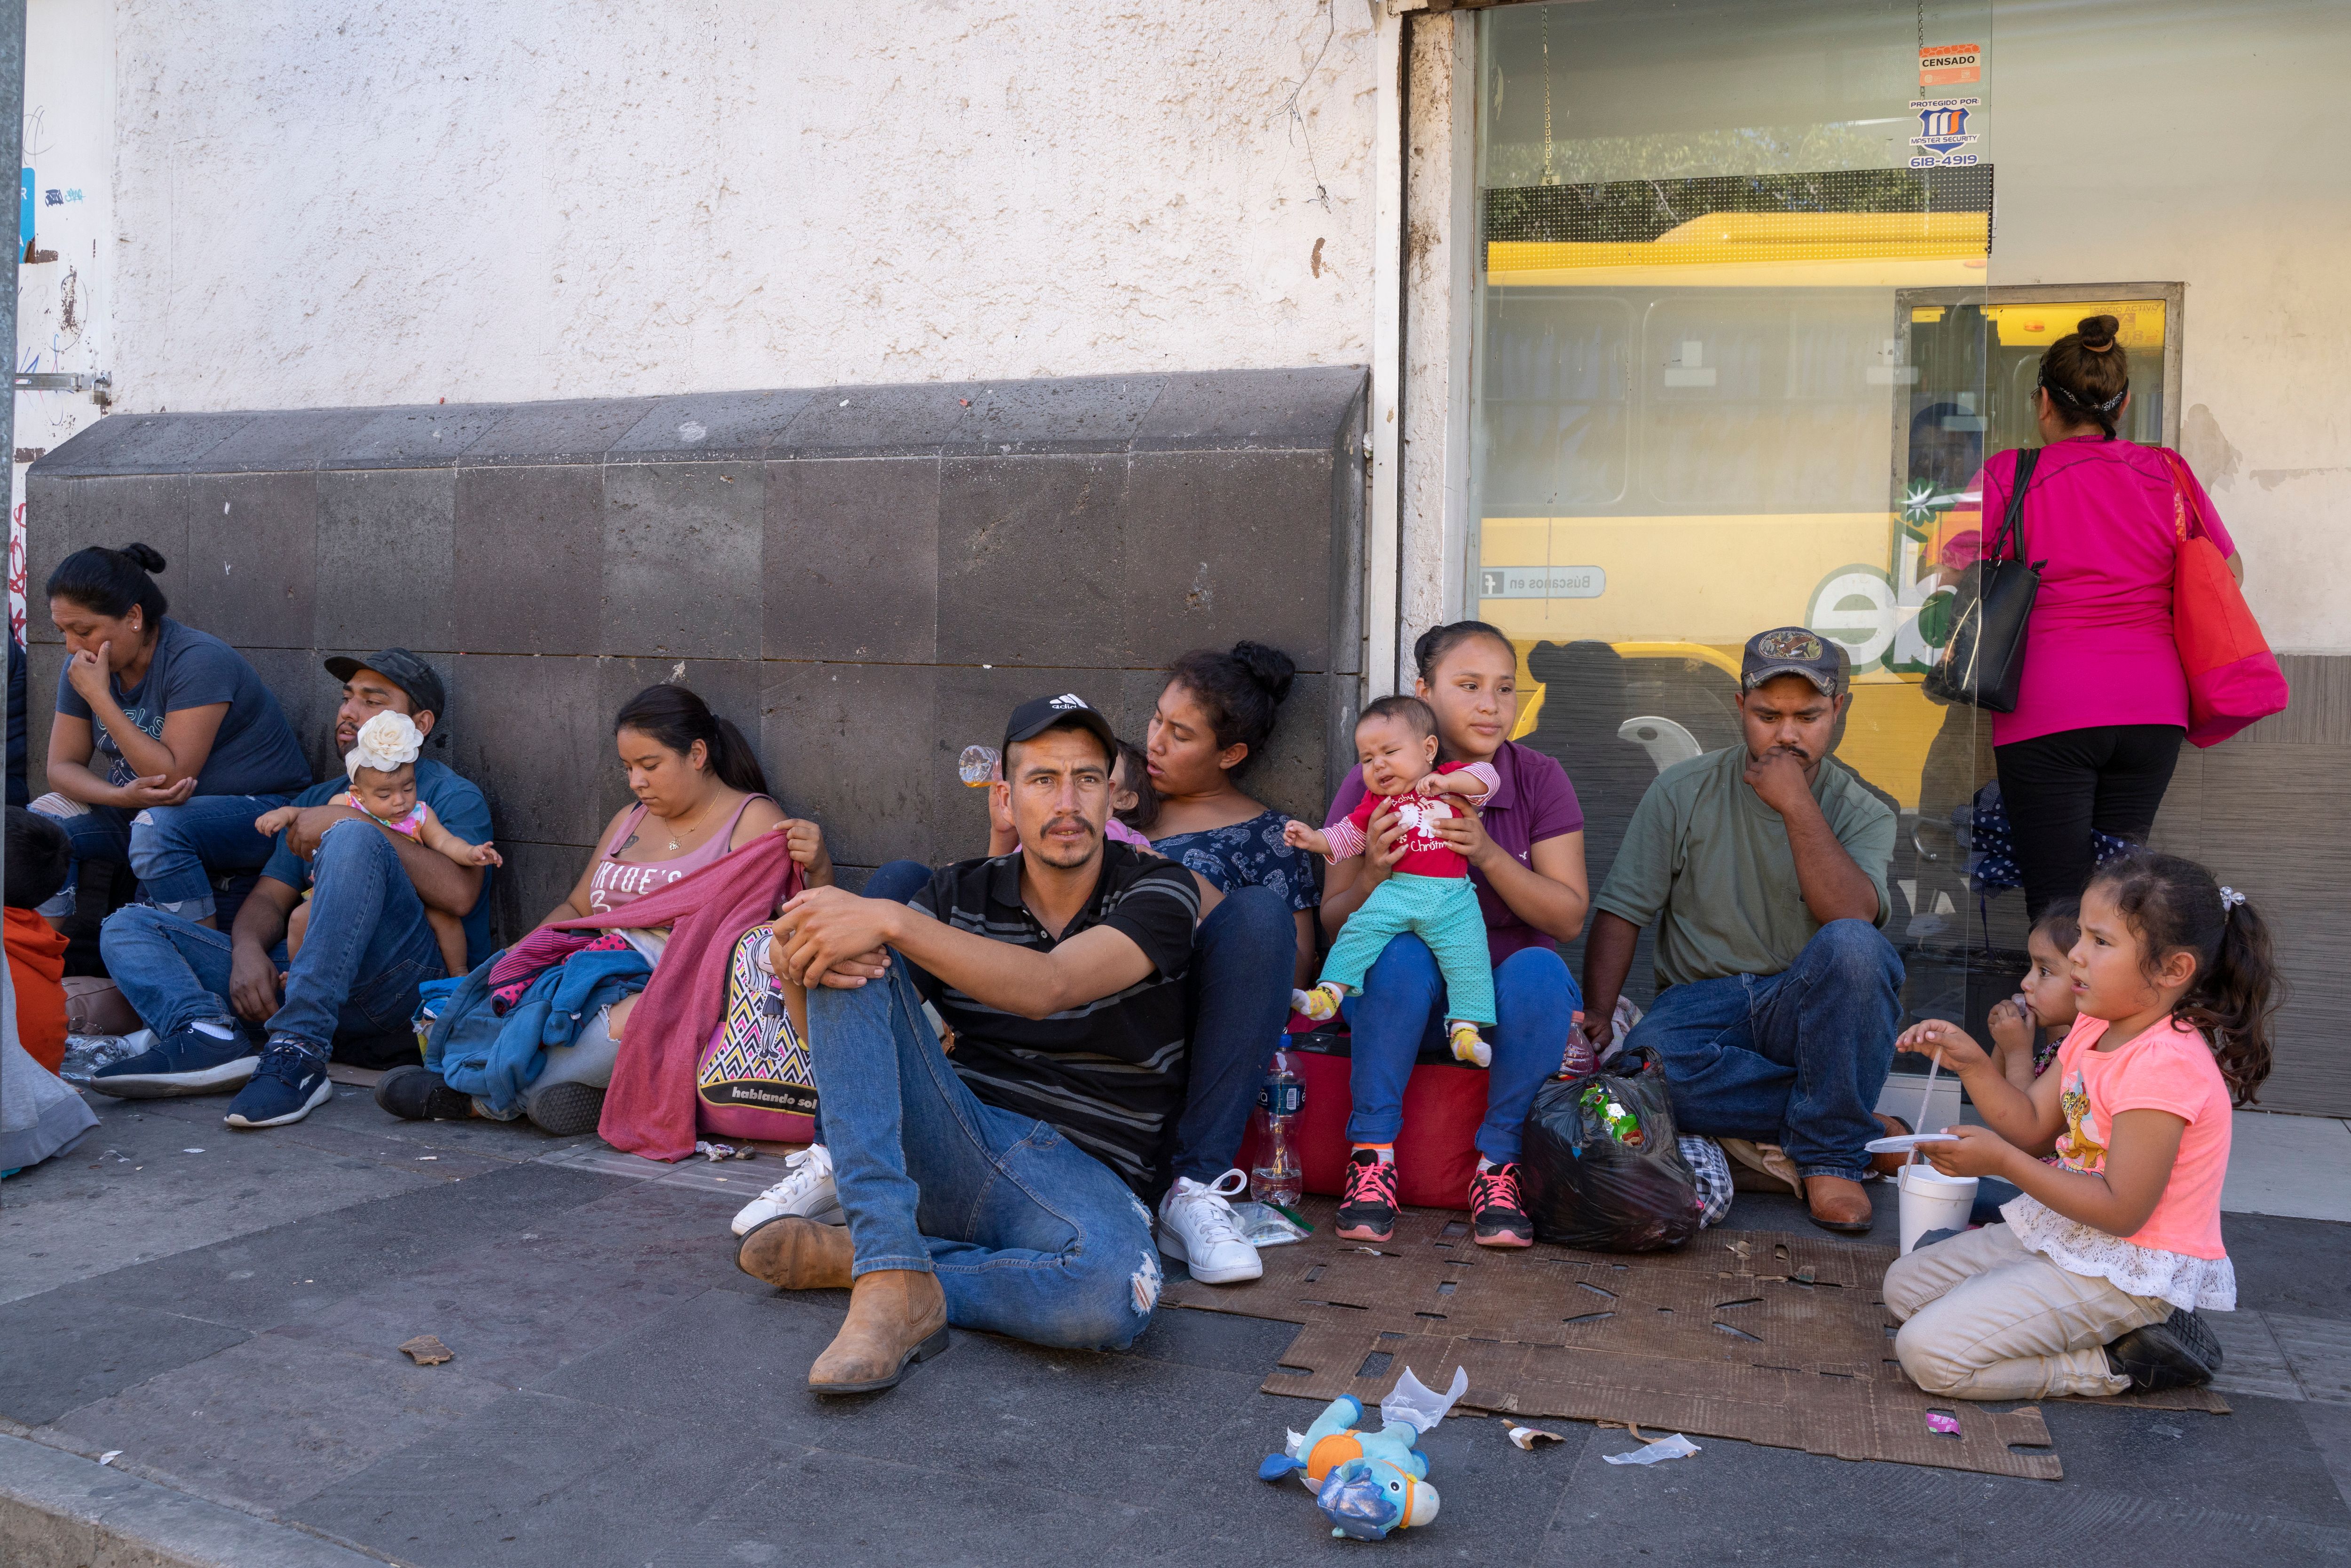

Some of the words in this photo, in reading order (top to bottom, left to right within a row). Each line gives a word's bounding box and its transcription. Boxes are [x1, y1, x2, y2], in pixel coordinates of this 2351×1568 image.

[1922, 55, 1975, 67] CENSADO
[1910, 155, 1977, 167] 618-4919
[1391, 794, 1415, 807] Baby
[732, 1086, 796, 1104] hablando
